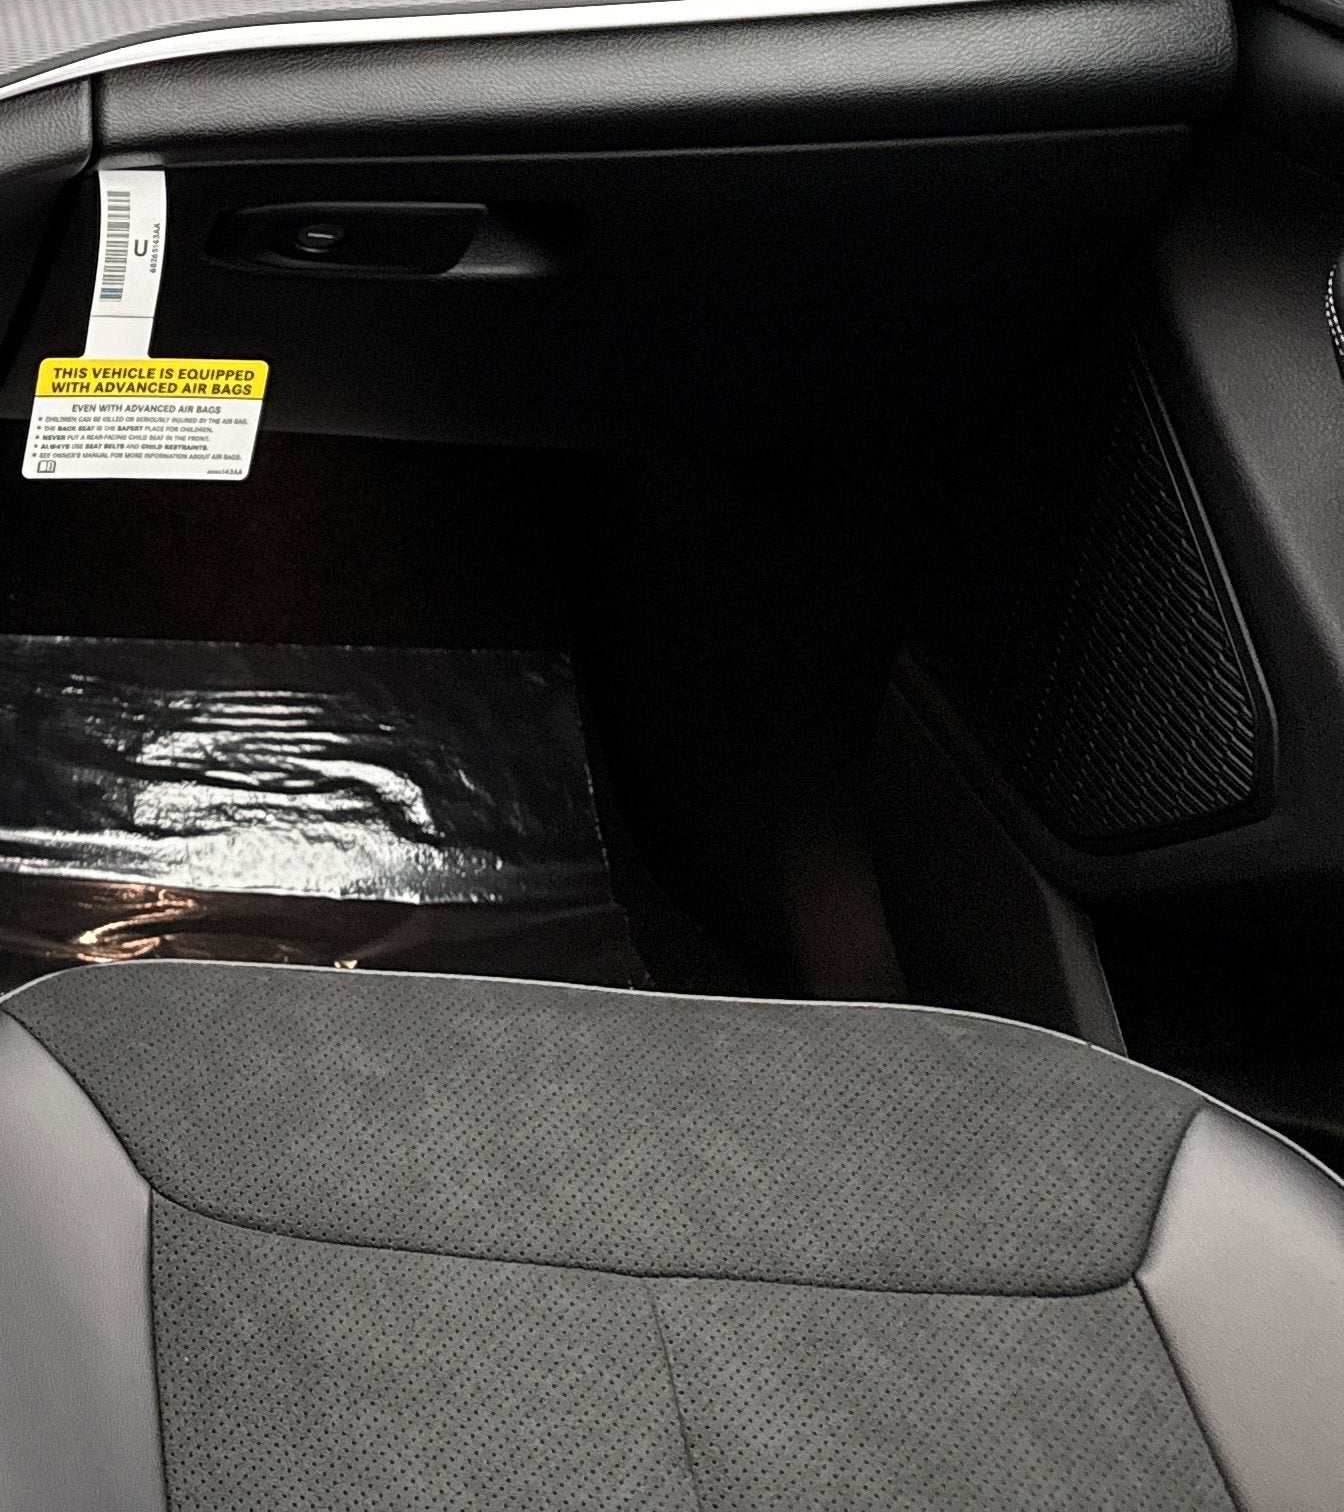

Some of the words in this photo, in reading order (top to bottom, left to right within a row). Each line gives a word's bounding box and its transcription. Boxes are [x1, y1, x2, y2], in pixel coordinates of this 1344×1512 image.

[134, 239, 148, 257] U
[53, 367, 88, 379] THIS
[92, 367, 157, 379] VEHICLE
[159, 368, 174, 379] IS
[178, 369, 255, 381] EQUIPPED
[51, 381, 91, 394] WITH
[93, 382, 178, 394] ADVANCED
[181, 383, 208, 395] AIR
[212, 383, 253, 396] BAGS
[72, 404, 97, 413] EVEN
[98, 404, 124, 413] WITH
[124, 404, 176, 413] ADVANCED
[177, 405, 194, 414] AIR
[196, 405, 222, 415] BAGS
